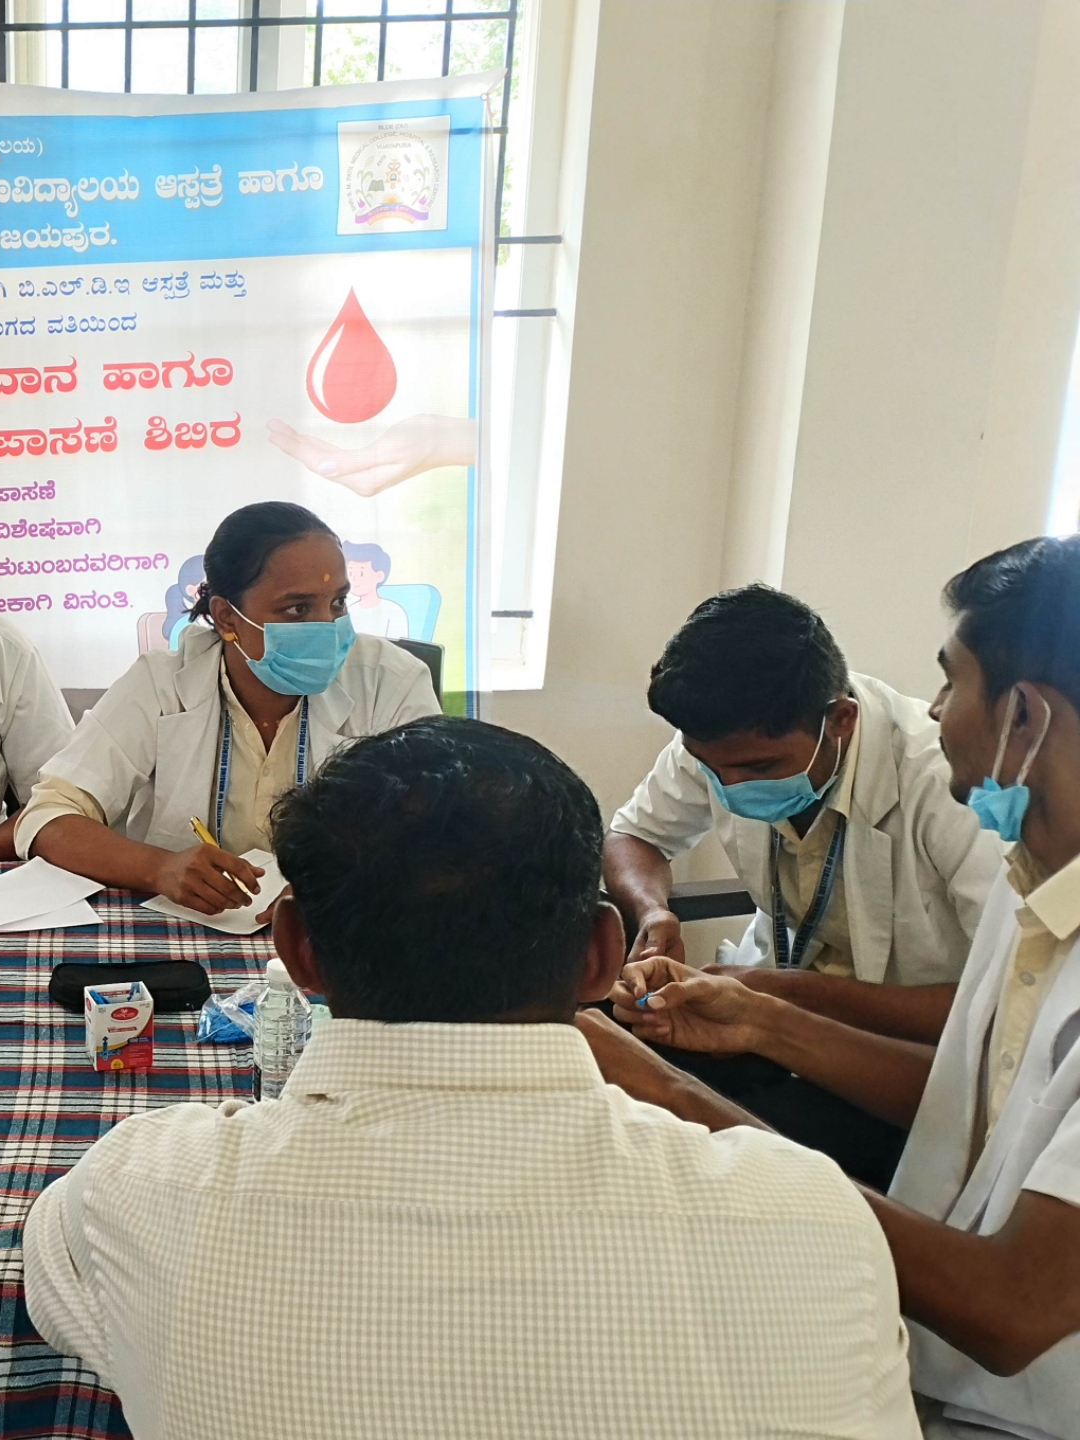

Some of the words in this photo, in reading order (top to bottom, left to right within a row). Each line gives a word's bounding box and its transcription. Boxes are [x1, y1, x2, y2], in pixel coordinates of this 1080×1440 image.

[154, 164, 223, 209] ಆಸ್ಪತ್ರೆ
[238, 160, 325, 195] ಹಾಗೂ
[141, 271, 191, 300] ಆಸ್ಪತ್ರೆ
[199, 269, 248, 298] ಮತ್ತು
[47, 312, 138, 335] ವತಿಯಿಂದ
[102, 350, 235, 391] ಹಾಗೂ
[143, 410, 241, 452] ಶಿಬಿರ
[221, 740, 230, 766] SCIENCES
